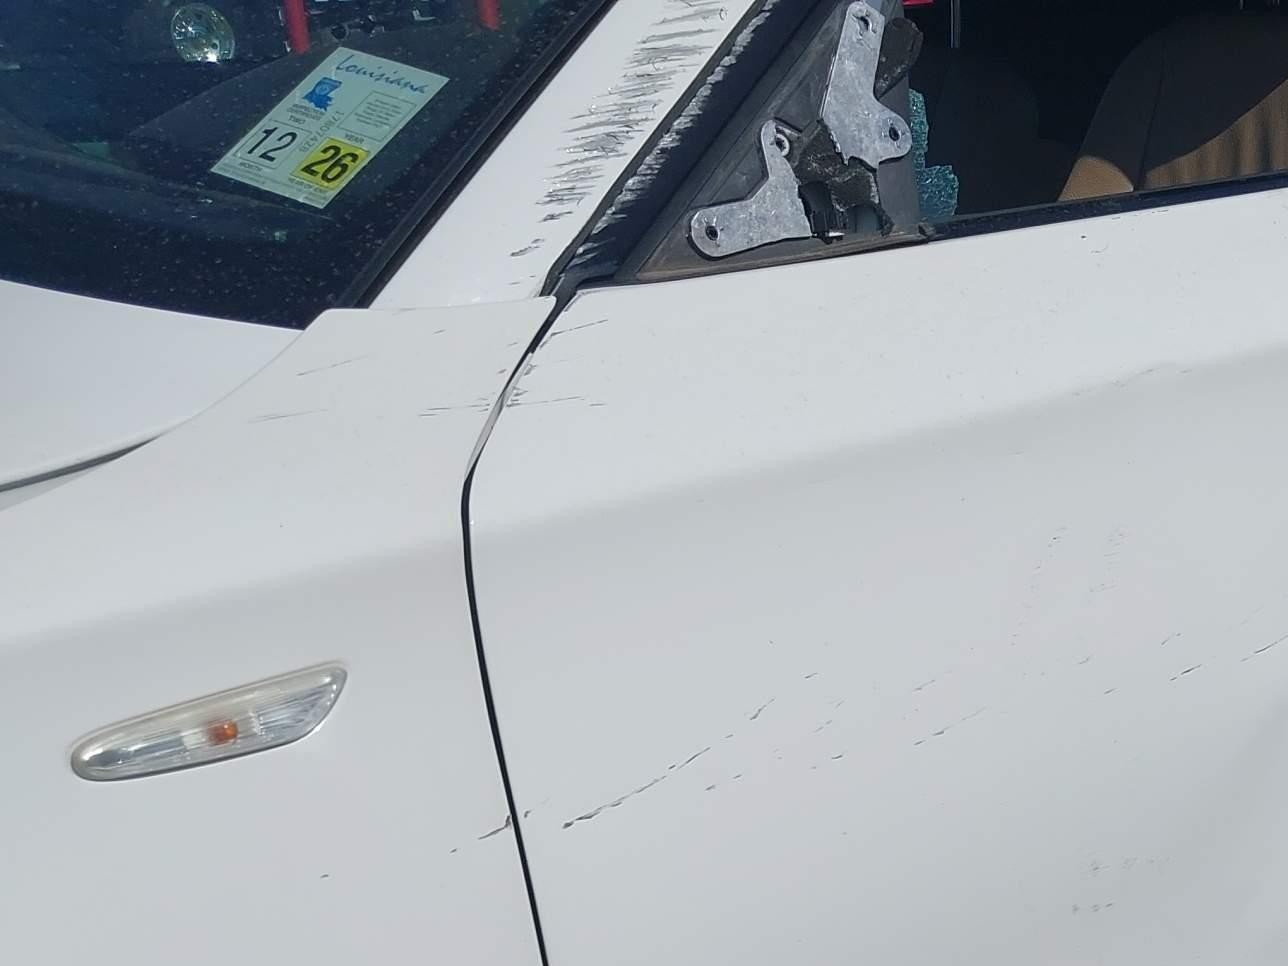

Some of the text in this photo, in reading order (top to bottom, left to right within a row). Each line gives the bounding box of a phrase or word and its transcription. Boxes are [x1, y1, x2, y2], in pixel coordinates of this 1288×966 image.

[335, 54, 428, 94] Louisiana
[247, 127, 298, 162] 12
[301, 145, 359, 184] 26
